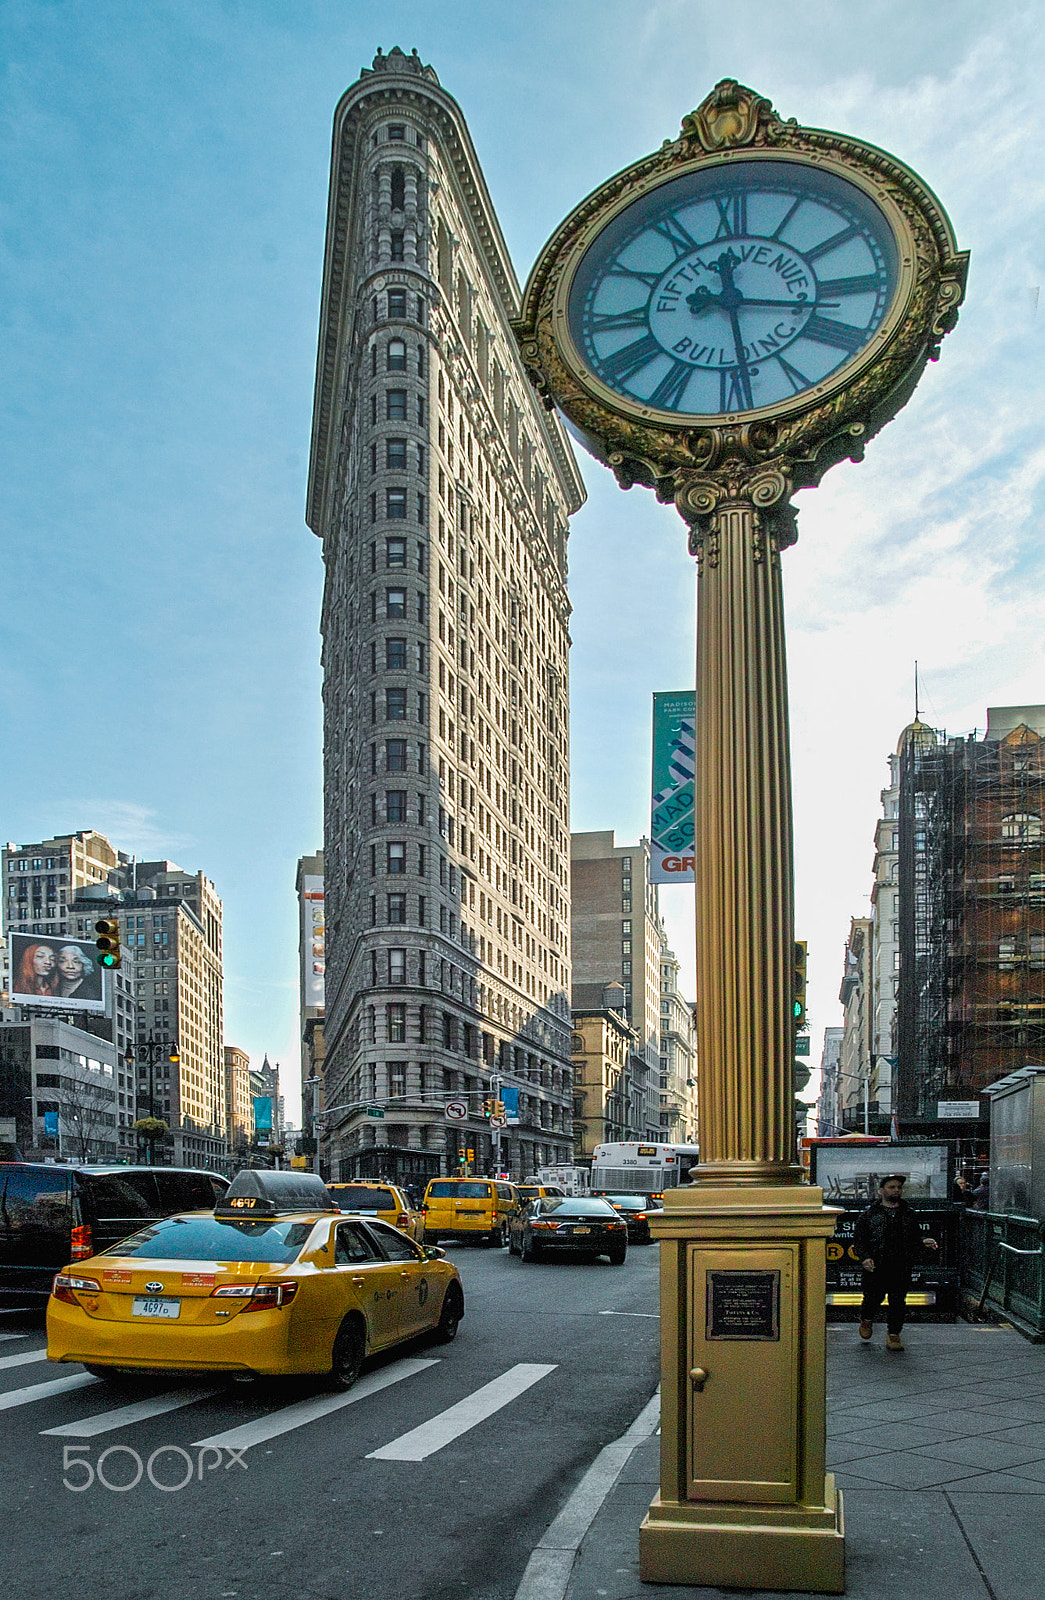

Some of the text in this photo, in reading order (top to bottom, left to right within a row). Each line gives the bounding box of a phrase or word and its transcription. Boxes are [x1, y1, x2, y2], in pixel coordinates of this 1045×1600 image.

[656, 245, 809, 313] FIFTH AVENUE
[672, 322, 796, 365] BUILDING
[652, 792, 694, 832] MAD
[828, 1246, 839, 1257] R
